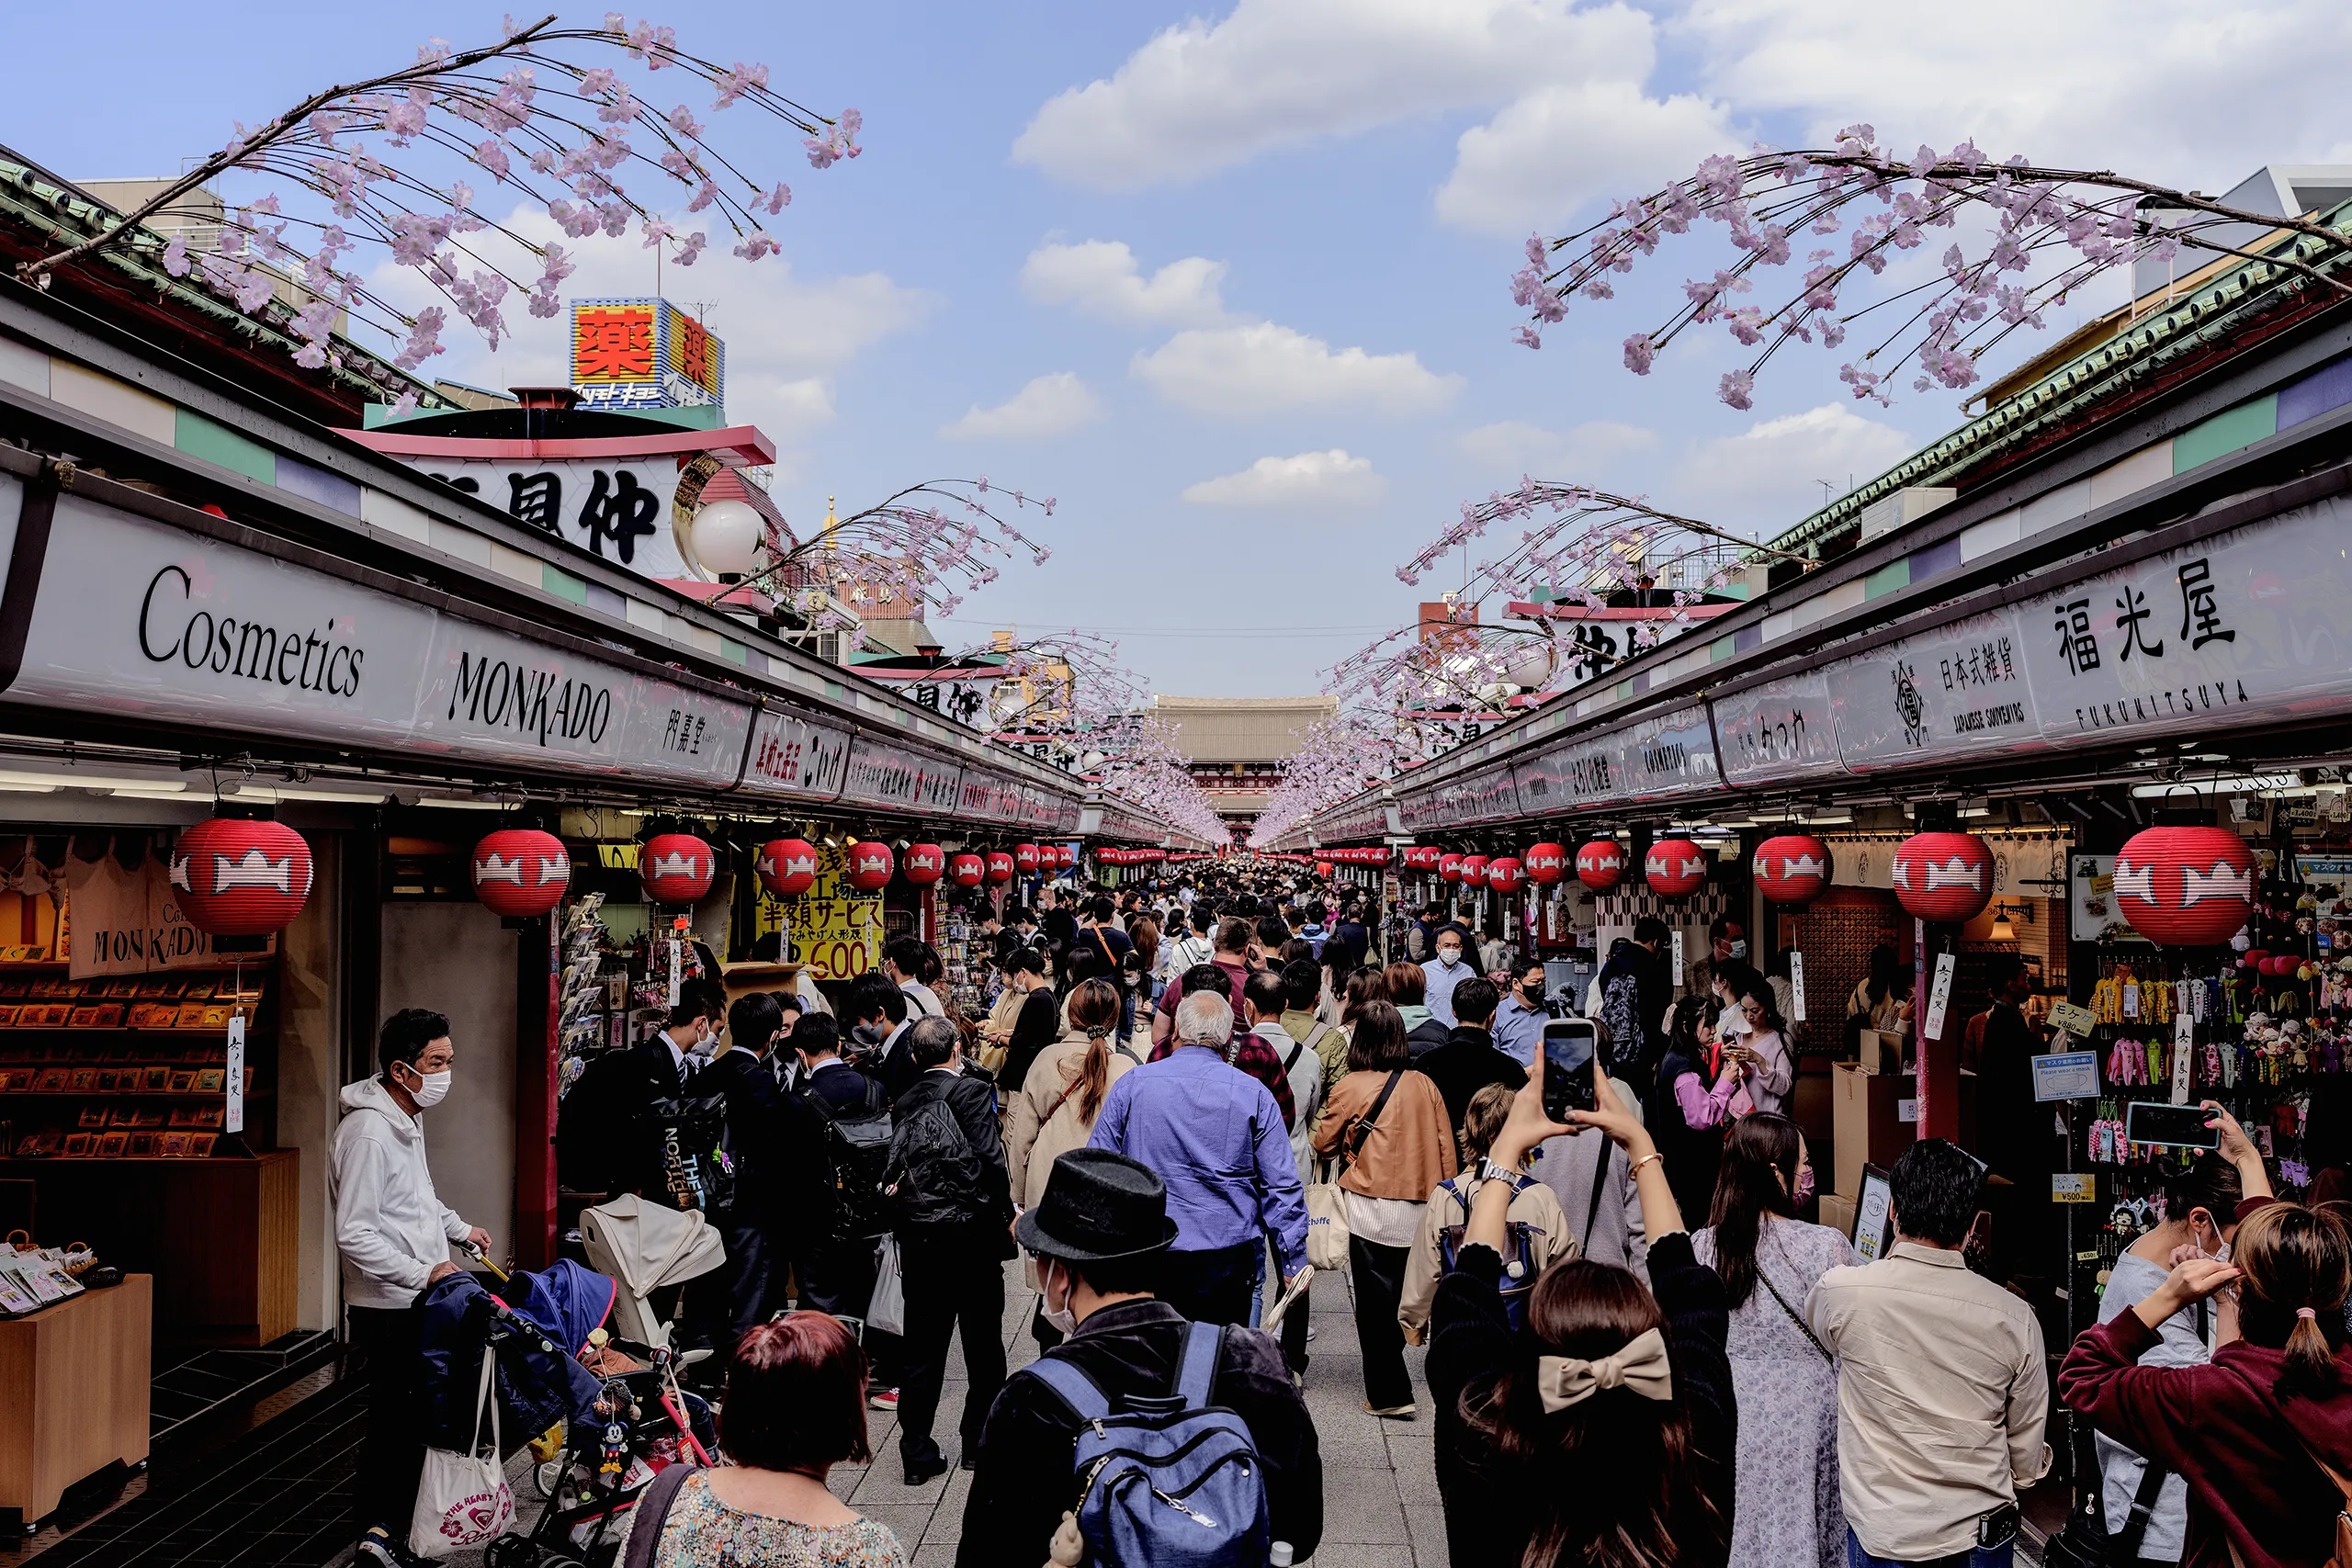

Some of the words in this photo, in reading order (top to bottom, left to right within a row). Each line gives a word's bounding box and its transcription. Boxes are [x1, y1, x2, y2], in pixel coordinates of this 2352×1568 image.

[577, 310, 653, 378] 薬
[683, 316, 708, 386] 薬
[138, 565, 365, 698] Cosmetics
[2054, 558, 2236, 677] 福光屋
[1939, 637, 2017, 692] 日本式雑貨
[447, 651, 611, 748] MONKADO
[1953, 710, 1985, 734] JAPANESE
[1985, 702, 2025, 728] SOUVENIRS
[2075, 679, 2248, 730] FUKUMITSUYA
[662, 709, 706, 755] 門嘉堂
[1645, 742, 1687, 774] COSMETICS
[763, 901, 883, 931] 半額サービス
[94, 927, 206, 964] MONKADO
[2056, 1004, 2093, 1023] モケケ
[2057, 1019, 2076, 1031] ¥880
[2062, 1192, 2080, 1201] ¥500
[445, 1502, 464, 1518] THE
[464, 1493, 493, 1506] HEART
